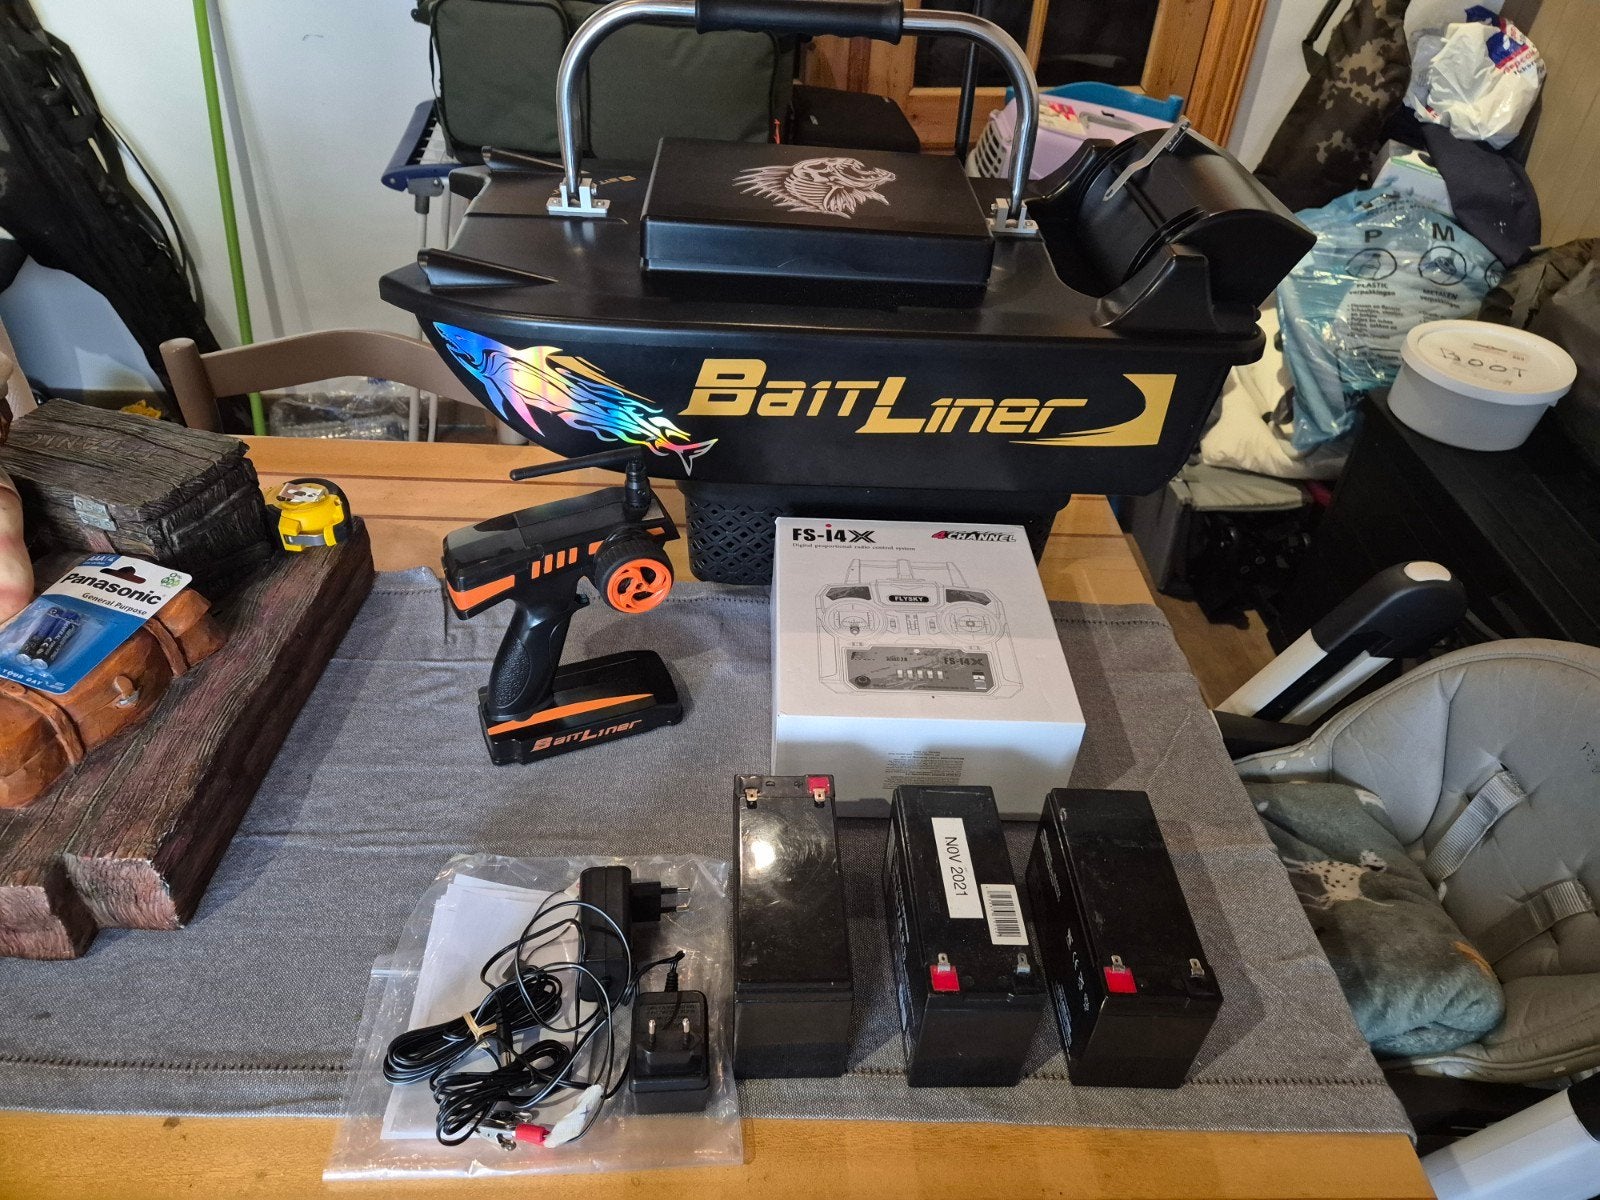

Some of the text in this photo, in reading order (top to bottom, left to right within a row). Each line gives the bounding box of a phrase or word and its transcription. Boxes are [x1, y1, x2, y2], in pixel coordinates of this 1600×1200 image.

[1364, 229, 1383, 243] P
[1432, 222, 1455, 242] M
[60, 572, 162, 605] Panasonic
[82, 592, 148, 616] General Purpose
[944, 836, 969, 897] NOV 2021
